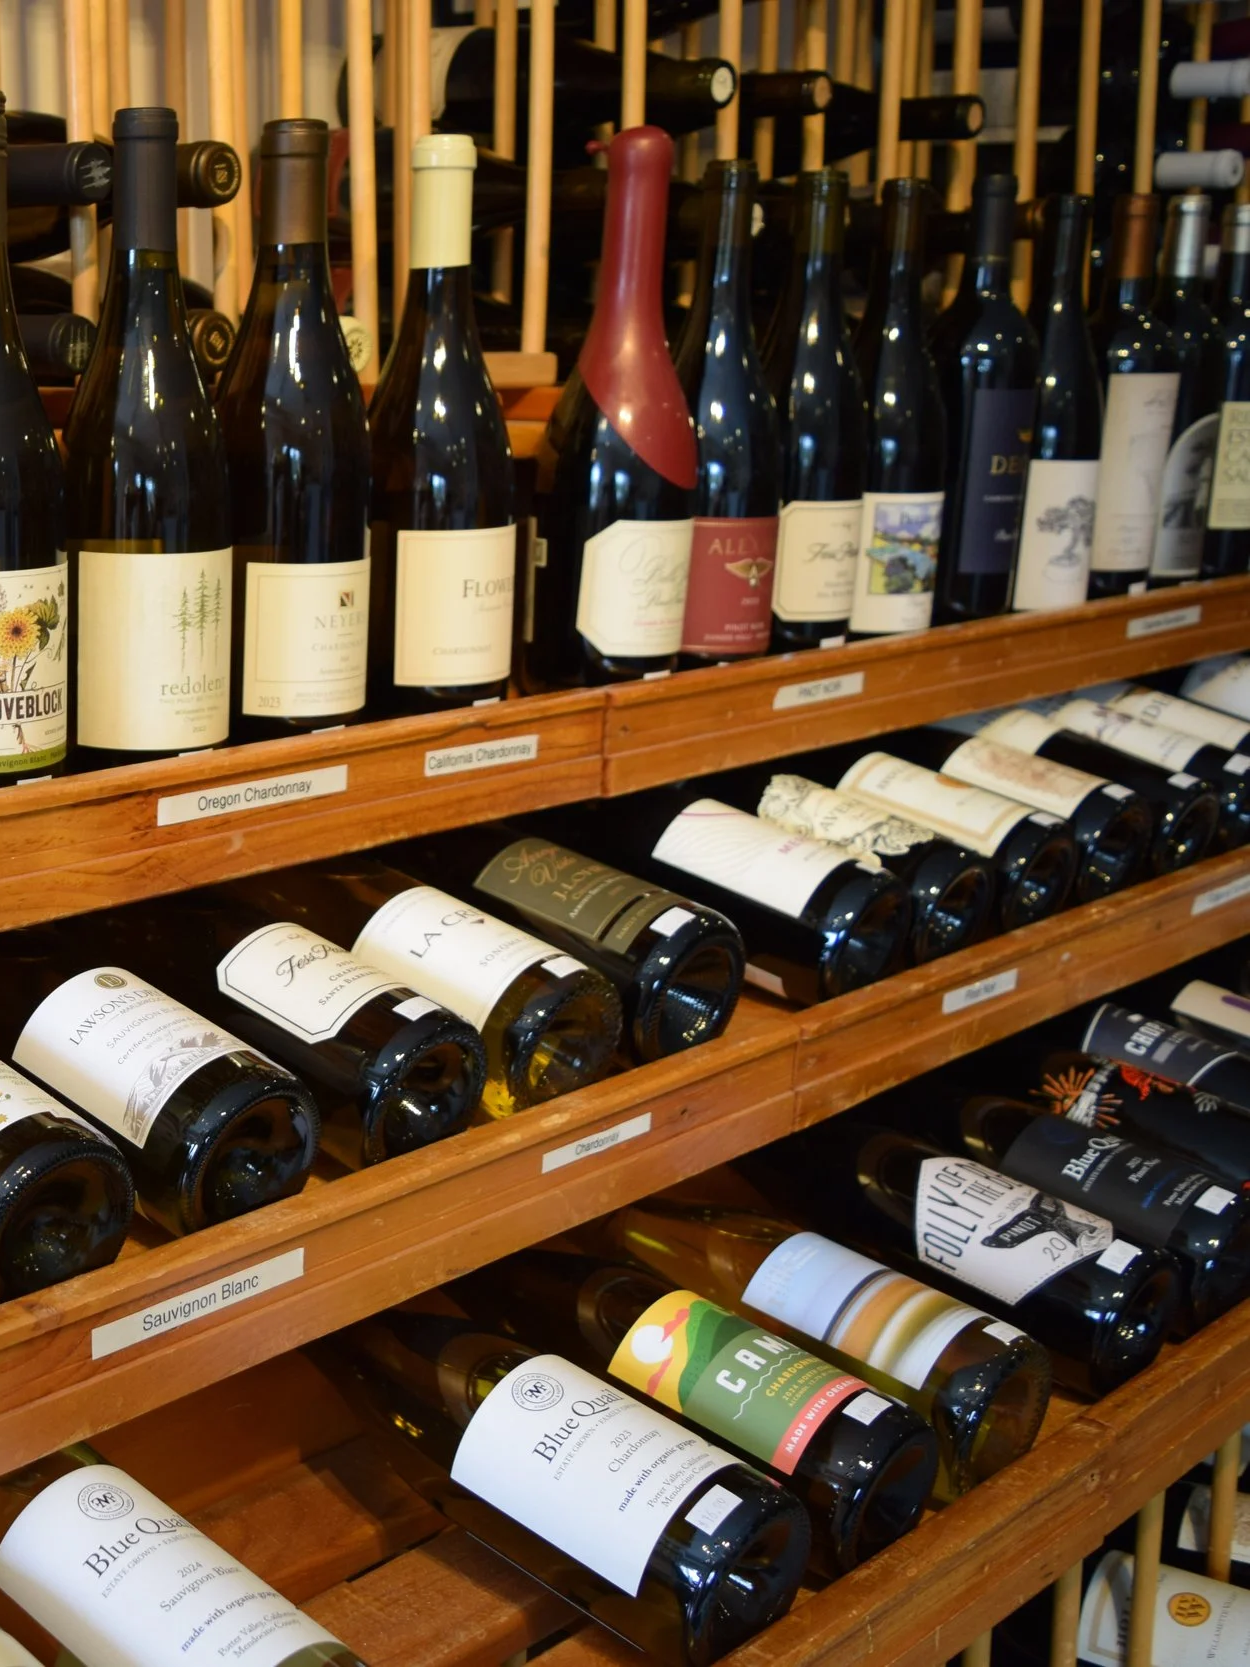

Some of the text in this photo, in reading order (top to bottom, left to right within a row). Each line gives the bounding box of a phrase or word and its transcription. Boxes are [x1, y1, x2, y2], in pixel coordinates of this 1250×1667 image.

[428, 744, 533, 770] California Chardonnay
[197, 777, 313, 812] Oregon Chardonnay
[409, 931, 442, 959] LA
[276, 952, 316, 987] Fess
[68, 990, 136, 1047] LAWSON'S
[106, 1008, 163, 1049] SAUVIGNON
[574, 1131, 621, 1156] Chardonnay
[1060, 1148, 1101, 1182] Blue
[923, 1184, 986, 1271] FOLLY
[1001, 1214, 1044, 1243] PINOT
[142, 1275, 260, 1332] Sauvignon Blanc
[531, 1388, 624, 1465] Blue Quail
[609, 1429, 633, 1449] 2023
[784, 1399, 828, 1454] MADE WITH
[553, 1450, 574, 1482] ESTATE
[571, 1427, 598, 1452] GROWN
[607, 1428, 662, 1474] Chardonnay
[617, 1487, 638, 1513] made
[634, 1468, 653, 1488] with
[650, 1445, 678, 1470] organic
[646, 1485, 667, 1509] Potter
[682, 1451, 711, 1471] California
[660, 1471, 695, 1509] Mendocino
[82, 1514, 194, 1578] Blue Quail
[101, 1569, 130, 1599] ESTATE
[128, 1545, 158, 1572] GROWN
[176, 1560, 204, 1580] 2024
[159, 1571, 217, 1613] Sauvignon
[180, 1624, 206, 1653] made
[203, 1607, 226, 1628] with
[225, 1589, 258, 1611] organic
[216, 1634, 243, 1658] Potter
[232, 1625, 276, 1660] Mendocino
